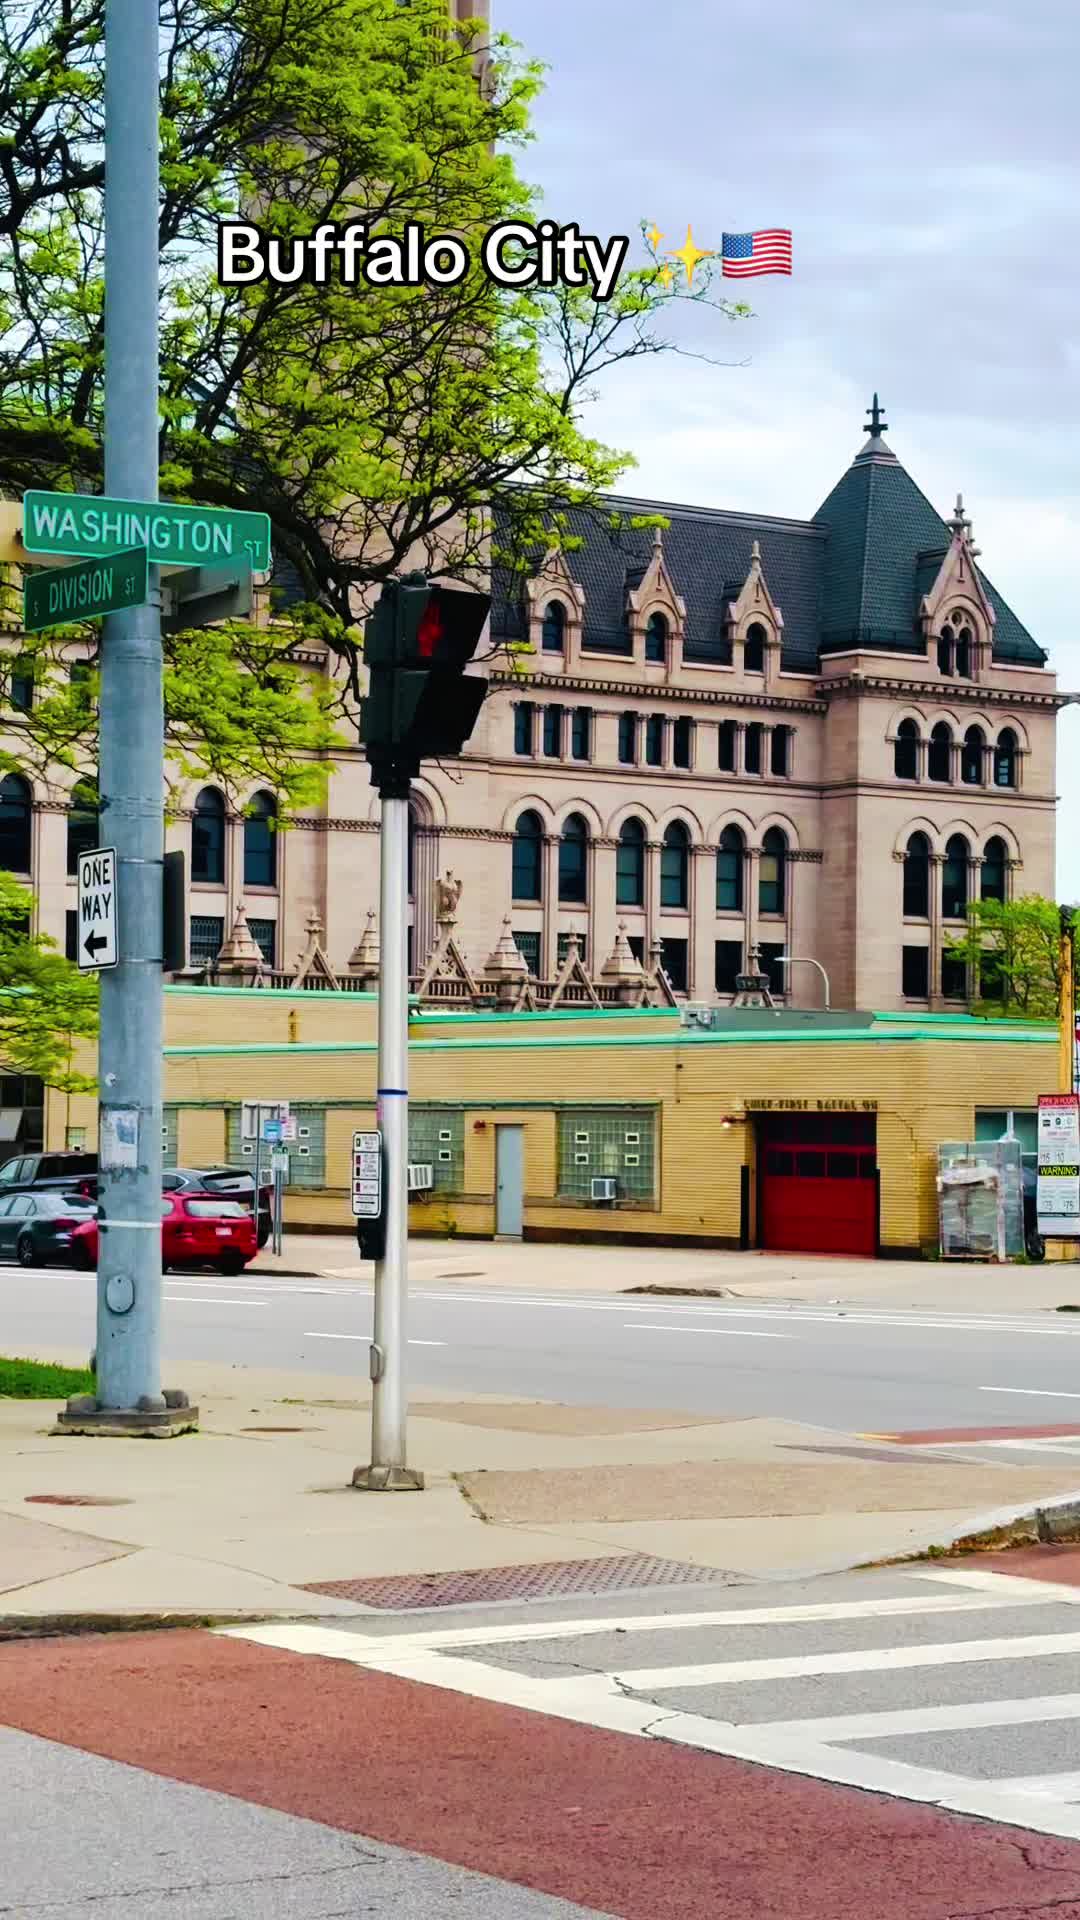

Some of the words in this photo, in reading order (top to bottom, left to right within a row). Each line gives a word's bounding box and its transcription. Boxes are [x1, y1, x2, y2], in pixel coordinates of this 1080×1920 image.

[33, 505, 233, 555] WASHINGTON
[243, 539, 263, 558] ST
[33, 600, 39, 617] S
[49, 567, 114, 613] DIVISION
[125, 575, 136, 596] ST
[83, 858, 111, 888] ONE
[82, 892, 112, 922] WAY
[1040, 1166, 1077, 1176] WARNING
